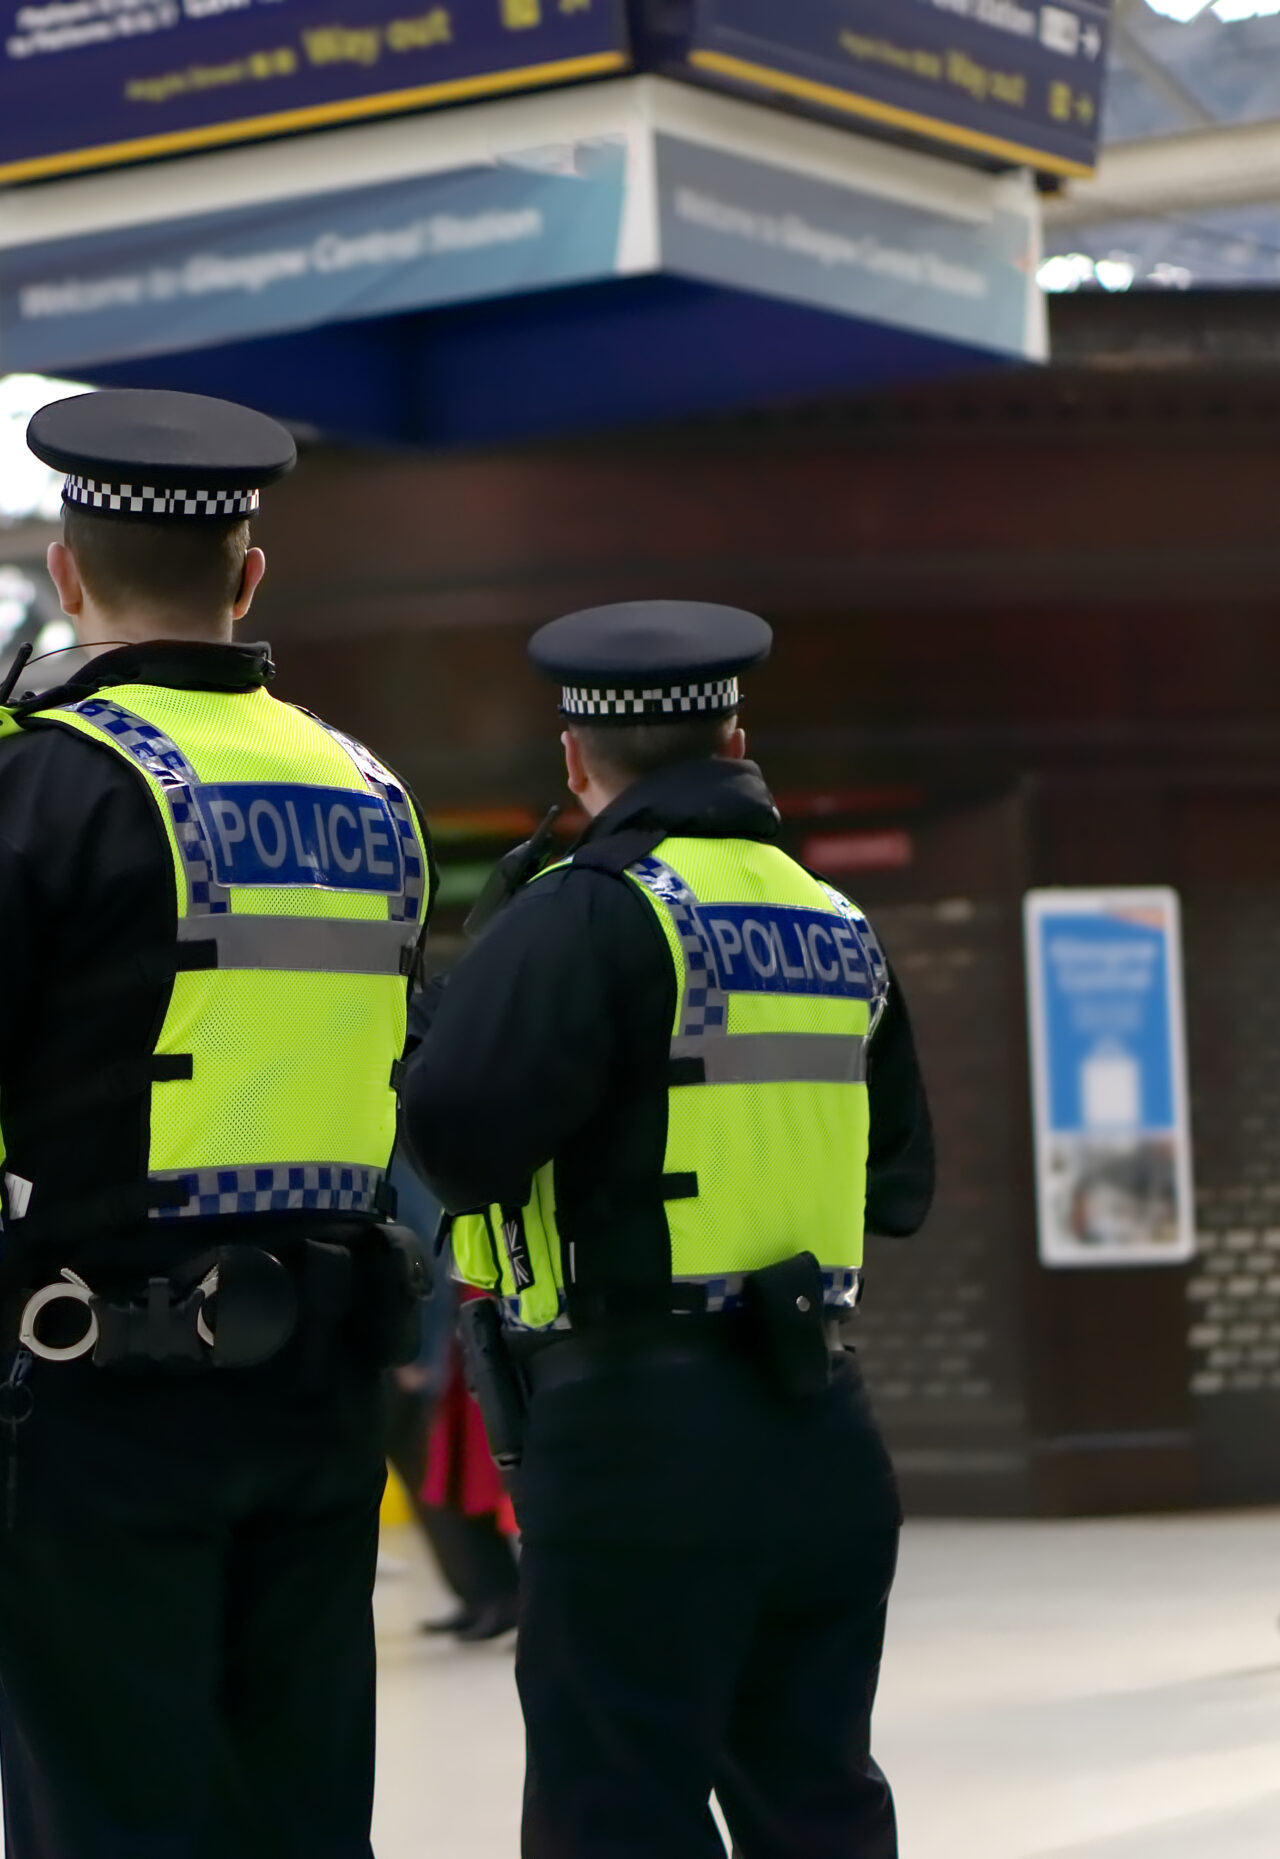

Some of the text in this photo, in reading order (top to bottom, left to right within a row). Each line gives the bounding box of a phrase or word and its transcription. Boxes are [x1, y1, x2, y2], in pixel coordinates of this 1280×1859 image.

[183, 252, 306, 294] Glasgow
[314, 220, 421, 274] Central
[431, 207, 543, 251] Station
[209, 799, 394, 875] POLICE
[708, 918, 867, 984] POLICE
